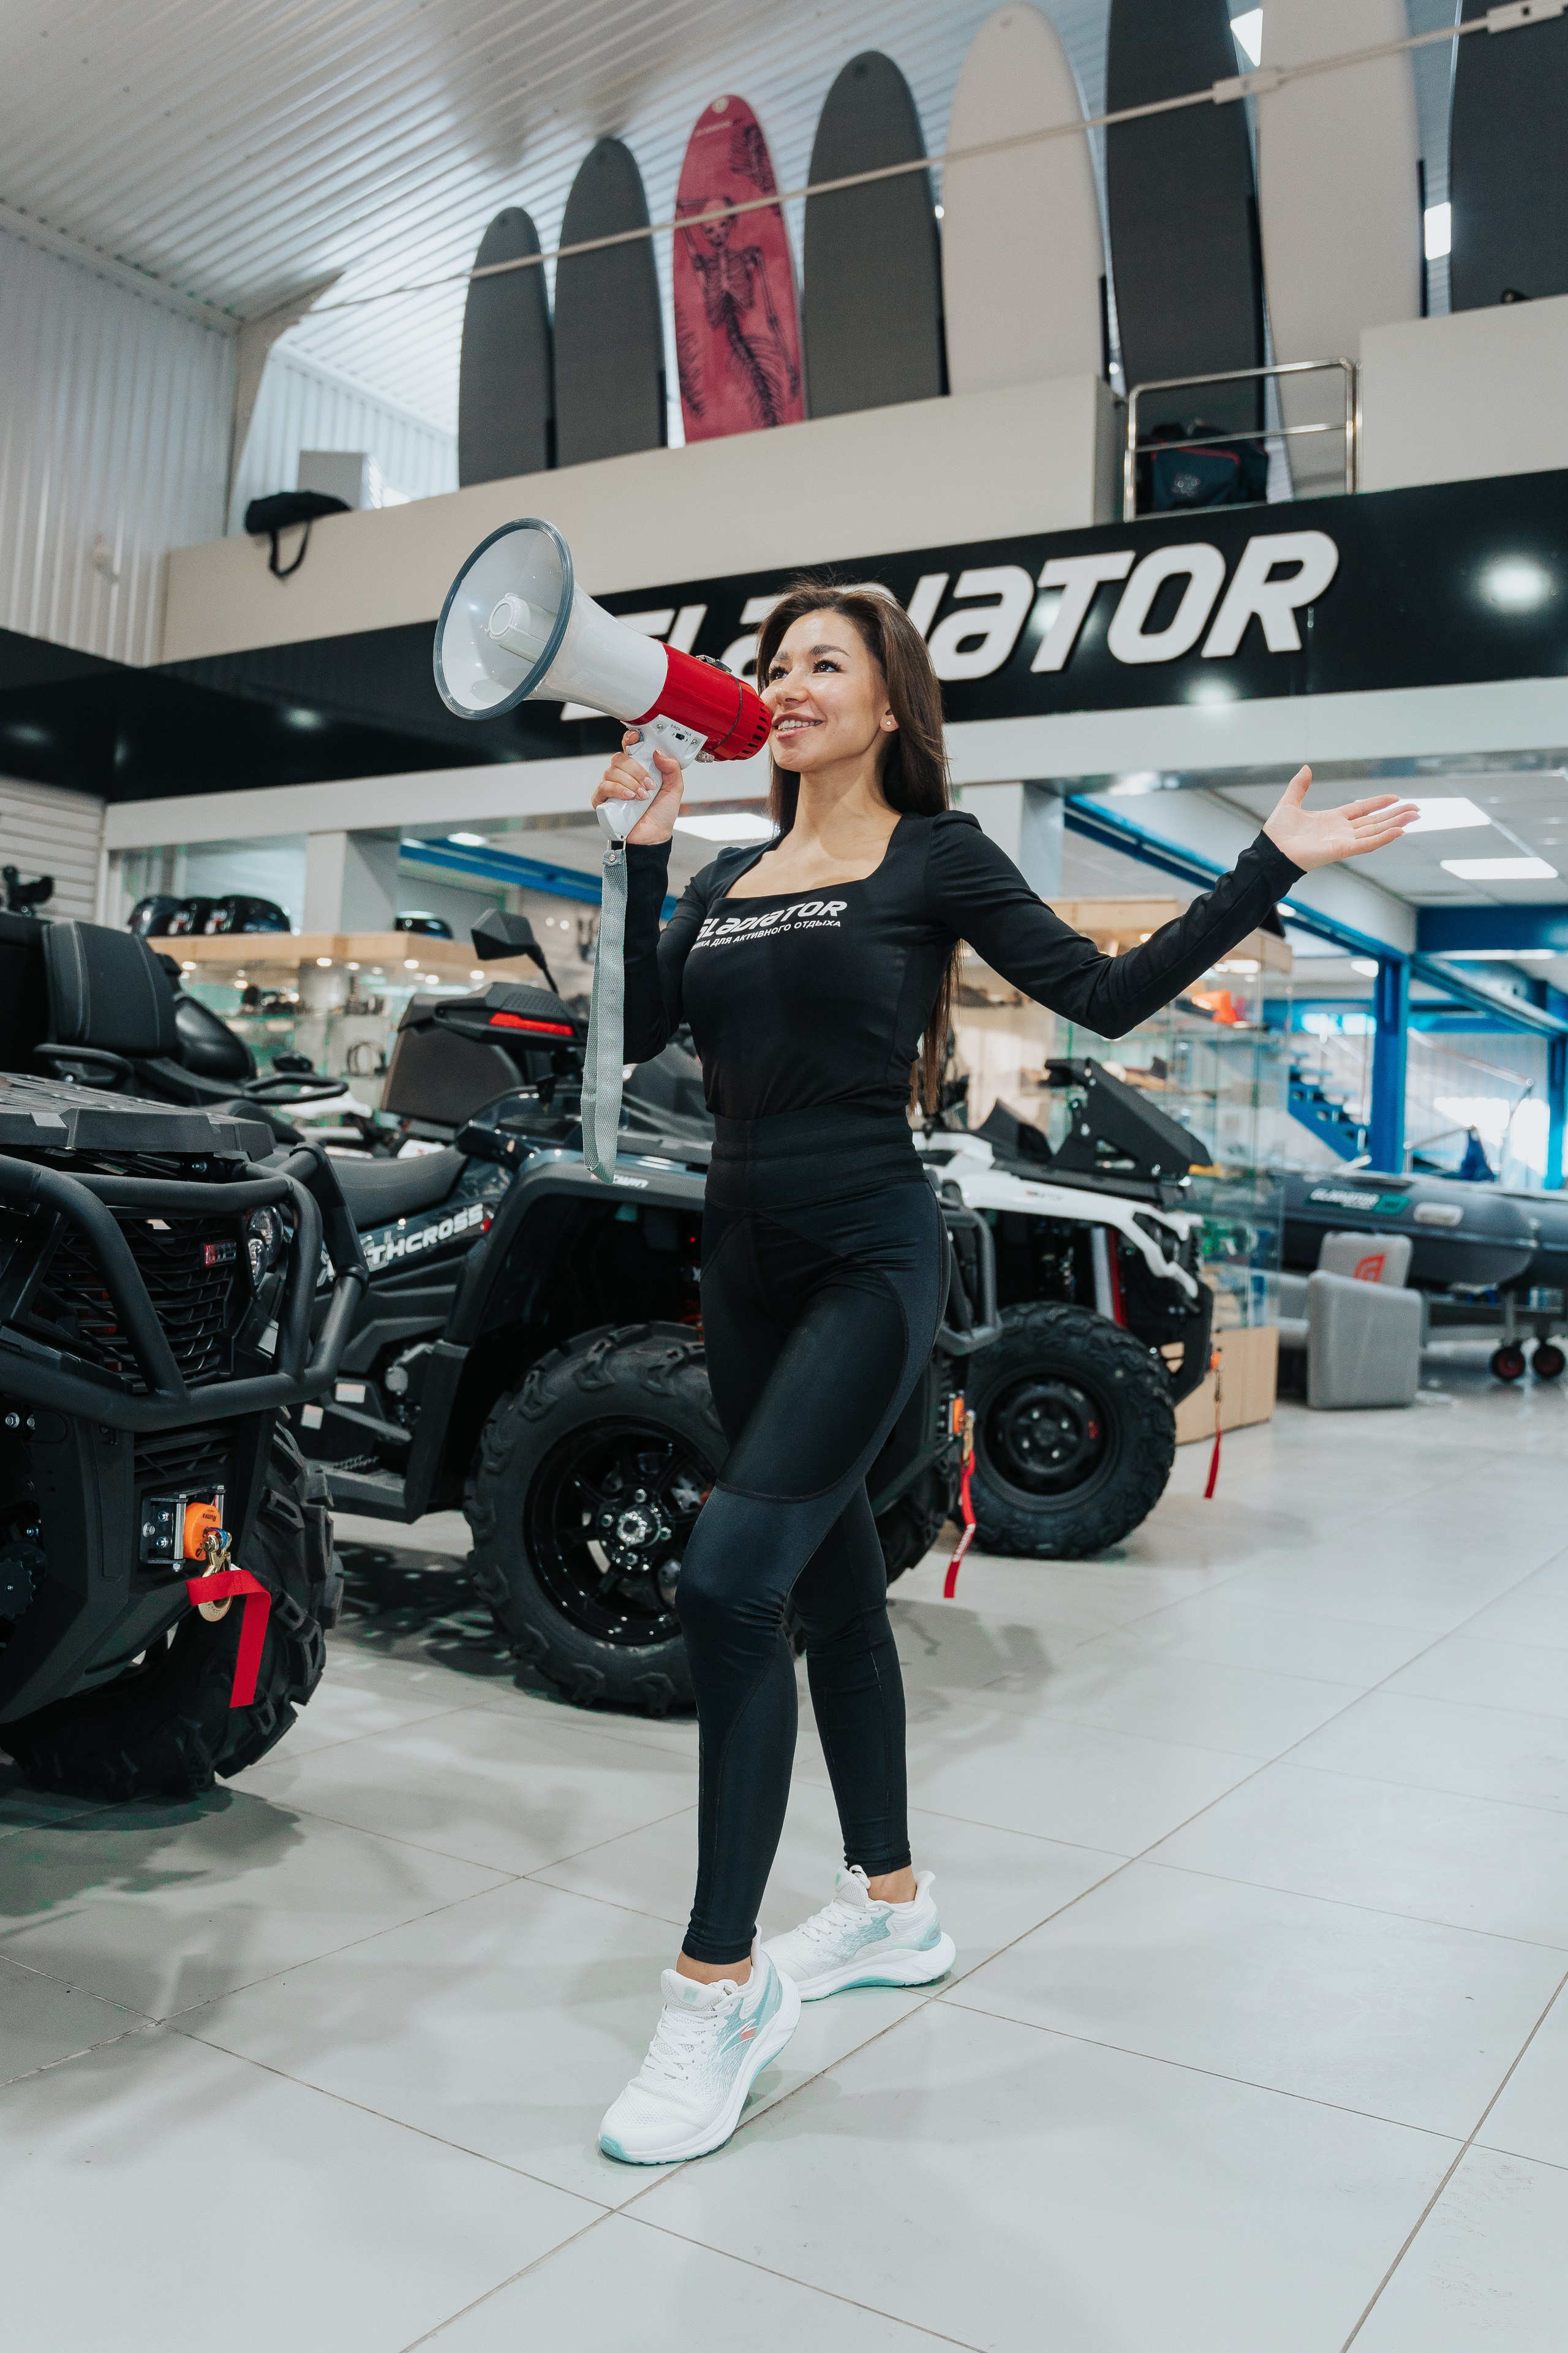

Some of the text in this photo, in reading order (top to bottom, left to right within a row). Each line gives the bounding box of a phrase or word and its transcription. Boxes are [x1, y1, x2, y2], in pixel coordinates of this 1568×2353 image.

[710, 936, 733, 948] ДЛЯ
[733, 923, 791, 943] АКТИВНОГО
[794, 920, 841, 929] ОТДЫХА
[363, 1203, 483, 1266] THCROSS
